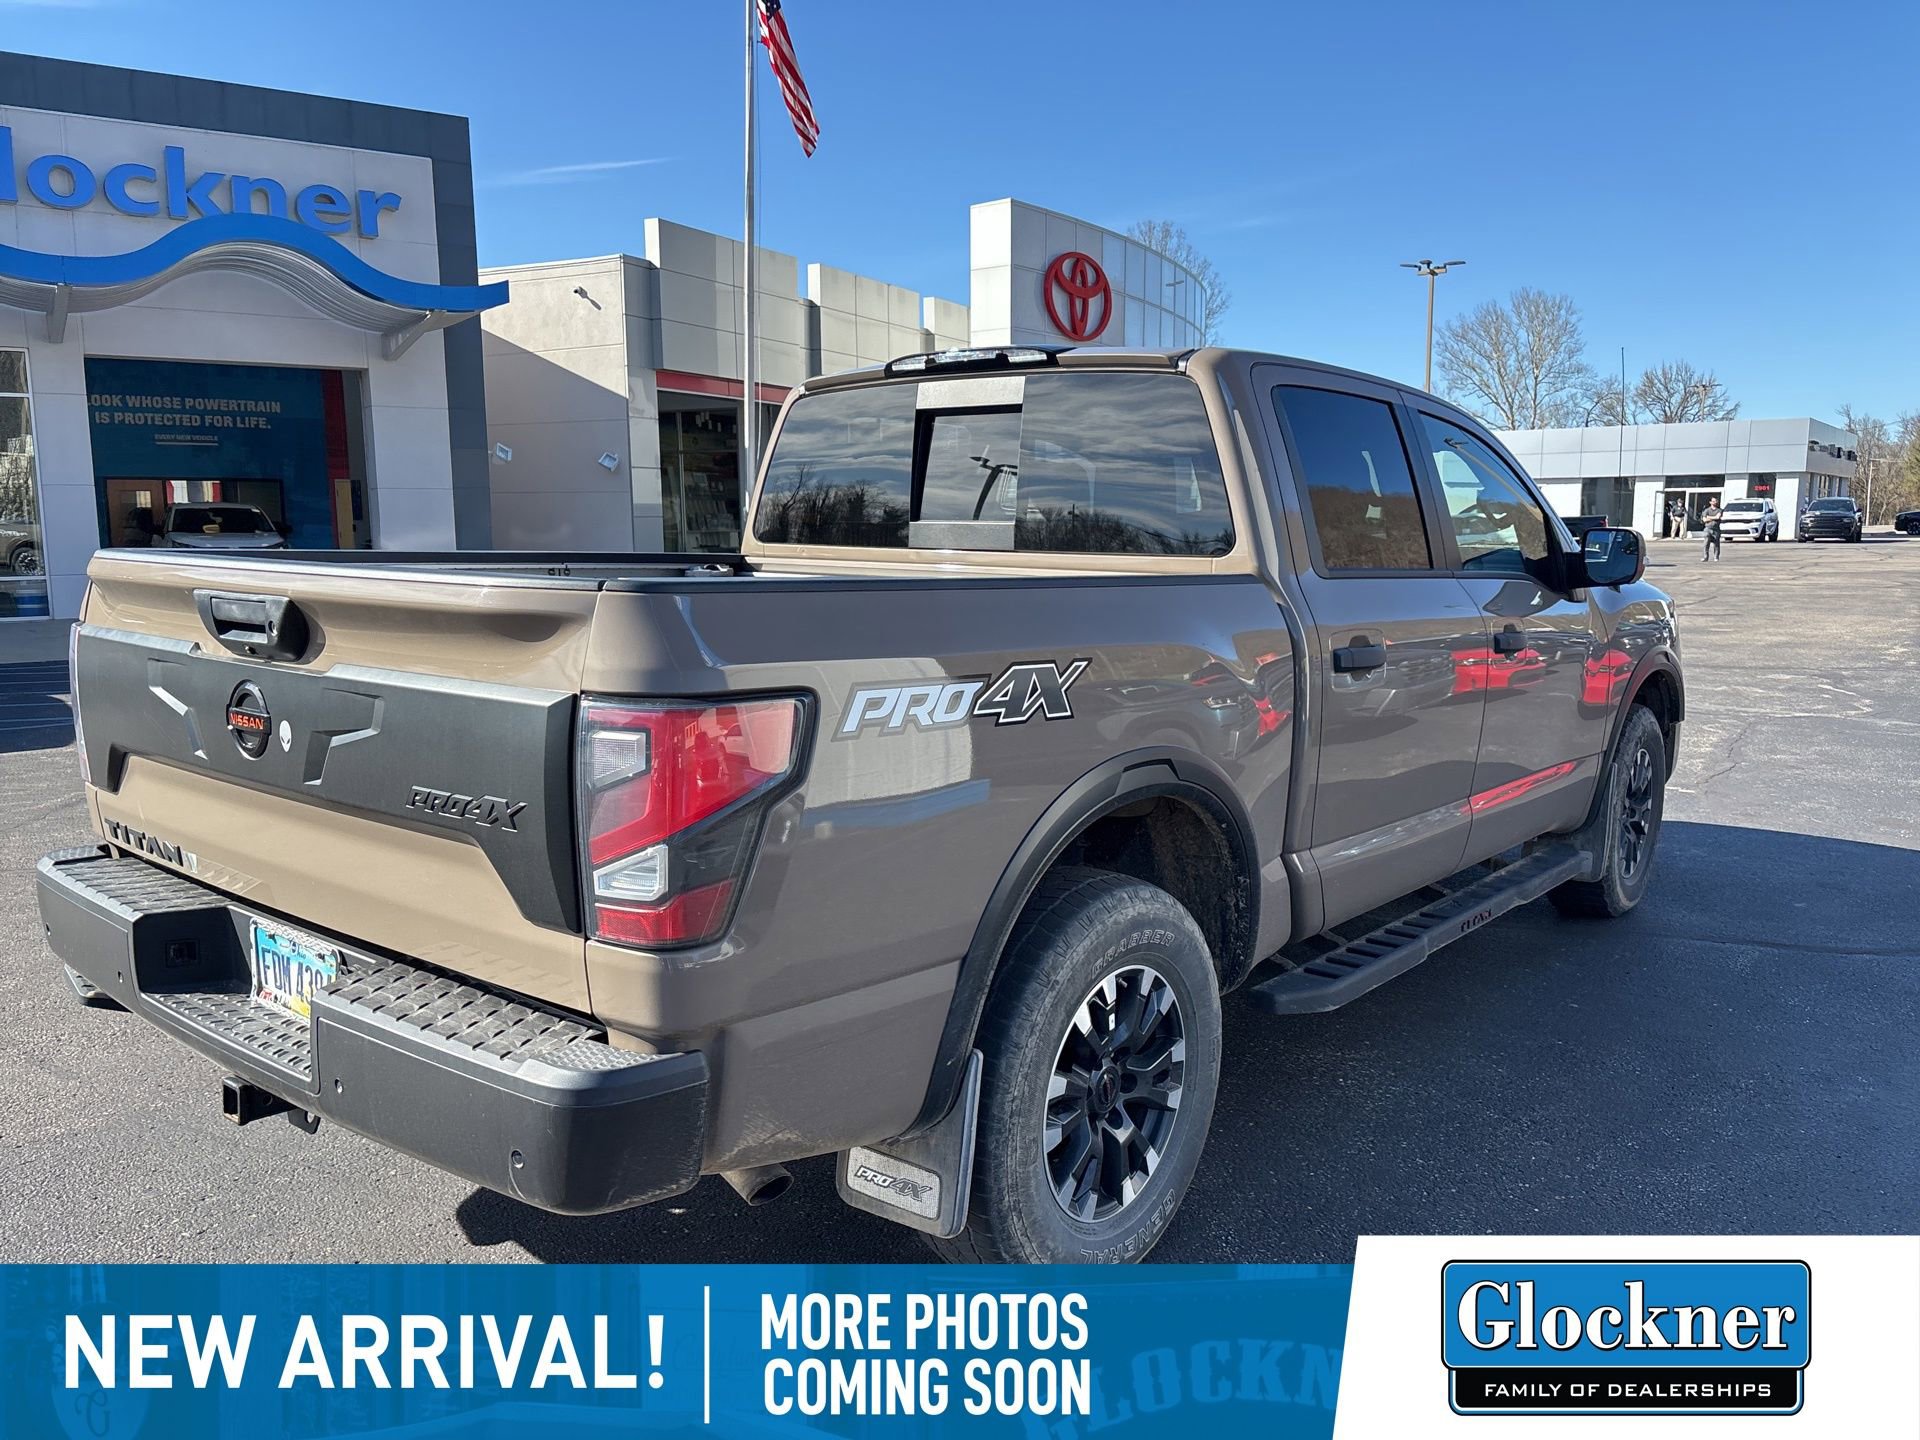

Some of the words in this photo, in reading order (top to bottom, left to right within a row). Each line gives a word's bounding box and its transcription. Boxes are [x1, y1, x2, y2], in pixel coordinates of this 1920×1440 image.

[88, 394, 123, 407] OOK
[125, 395, 182, 409] WHOSE
[185, 397, 281, 413] POWERTRAIN
[95, 411, 110, 424] IS
[114, 412, 201, 427] PROTECTED
[205, 415, 233, 428] FOR
[236, 416, 272, 430] LIFE.
[230, 712, 264, 730] NISSAN
[104, 818, 184, 868] TITAN
[261, 945, 292, 997] FDM
[1091, 929, 1175, 979] GRABBER
[1080, 1188, 1176, 1264] GENERAL
